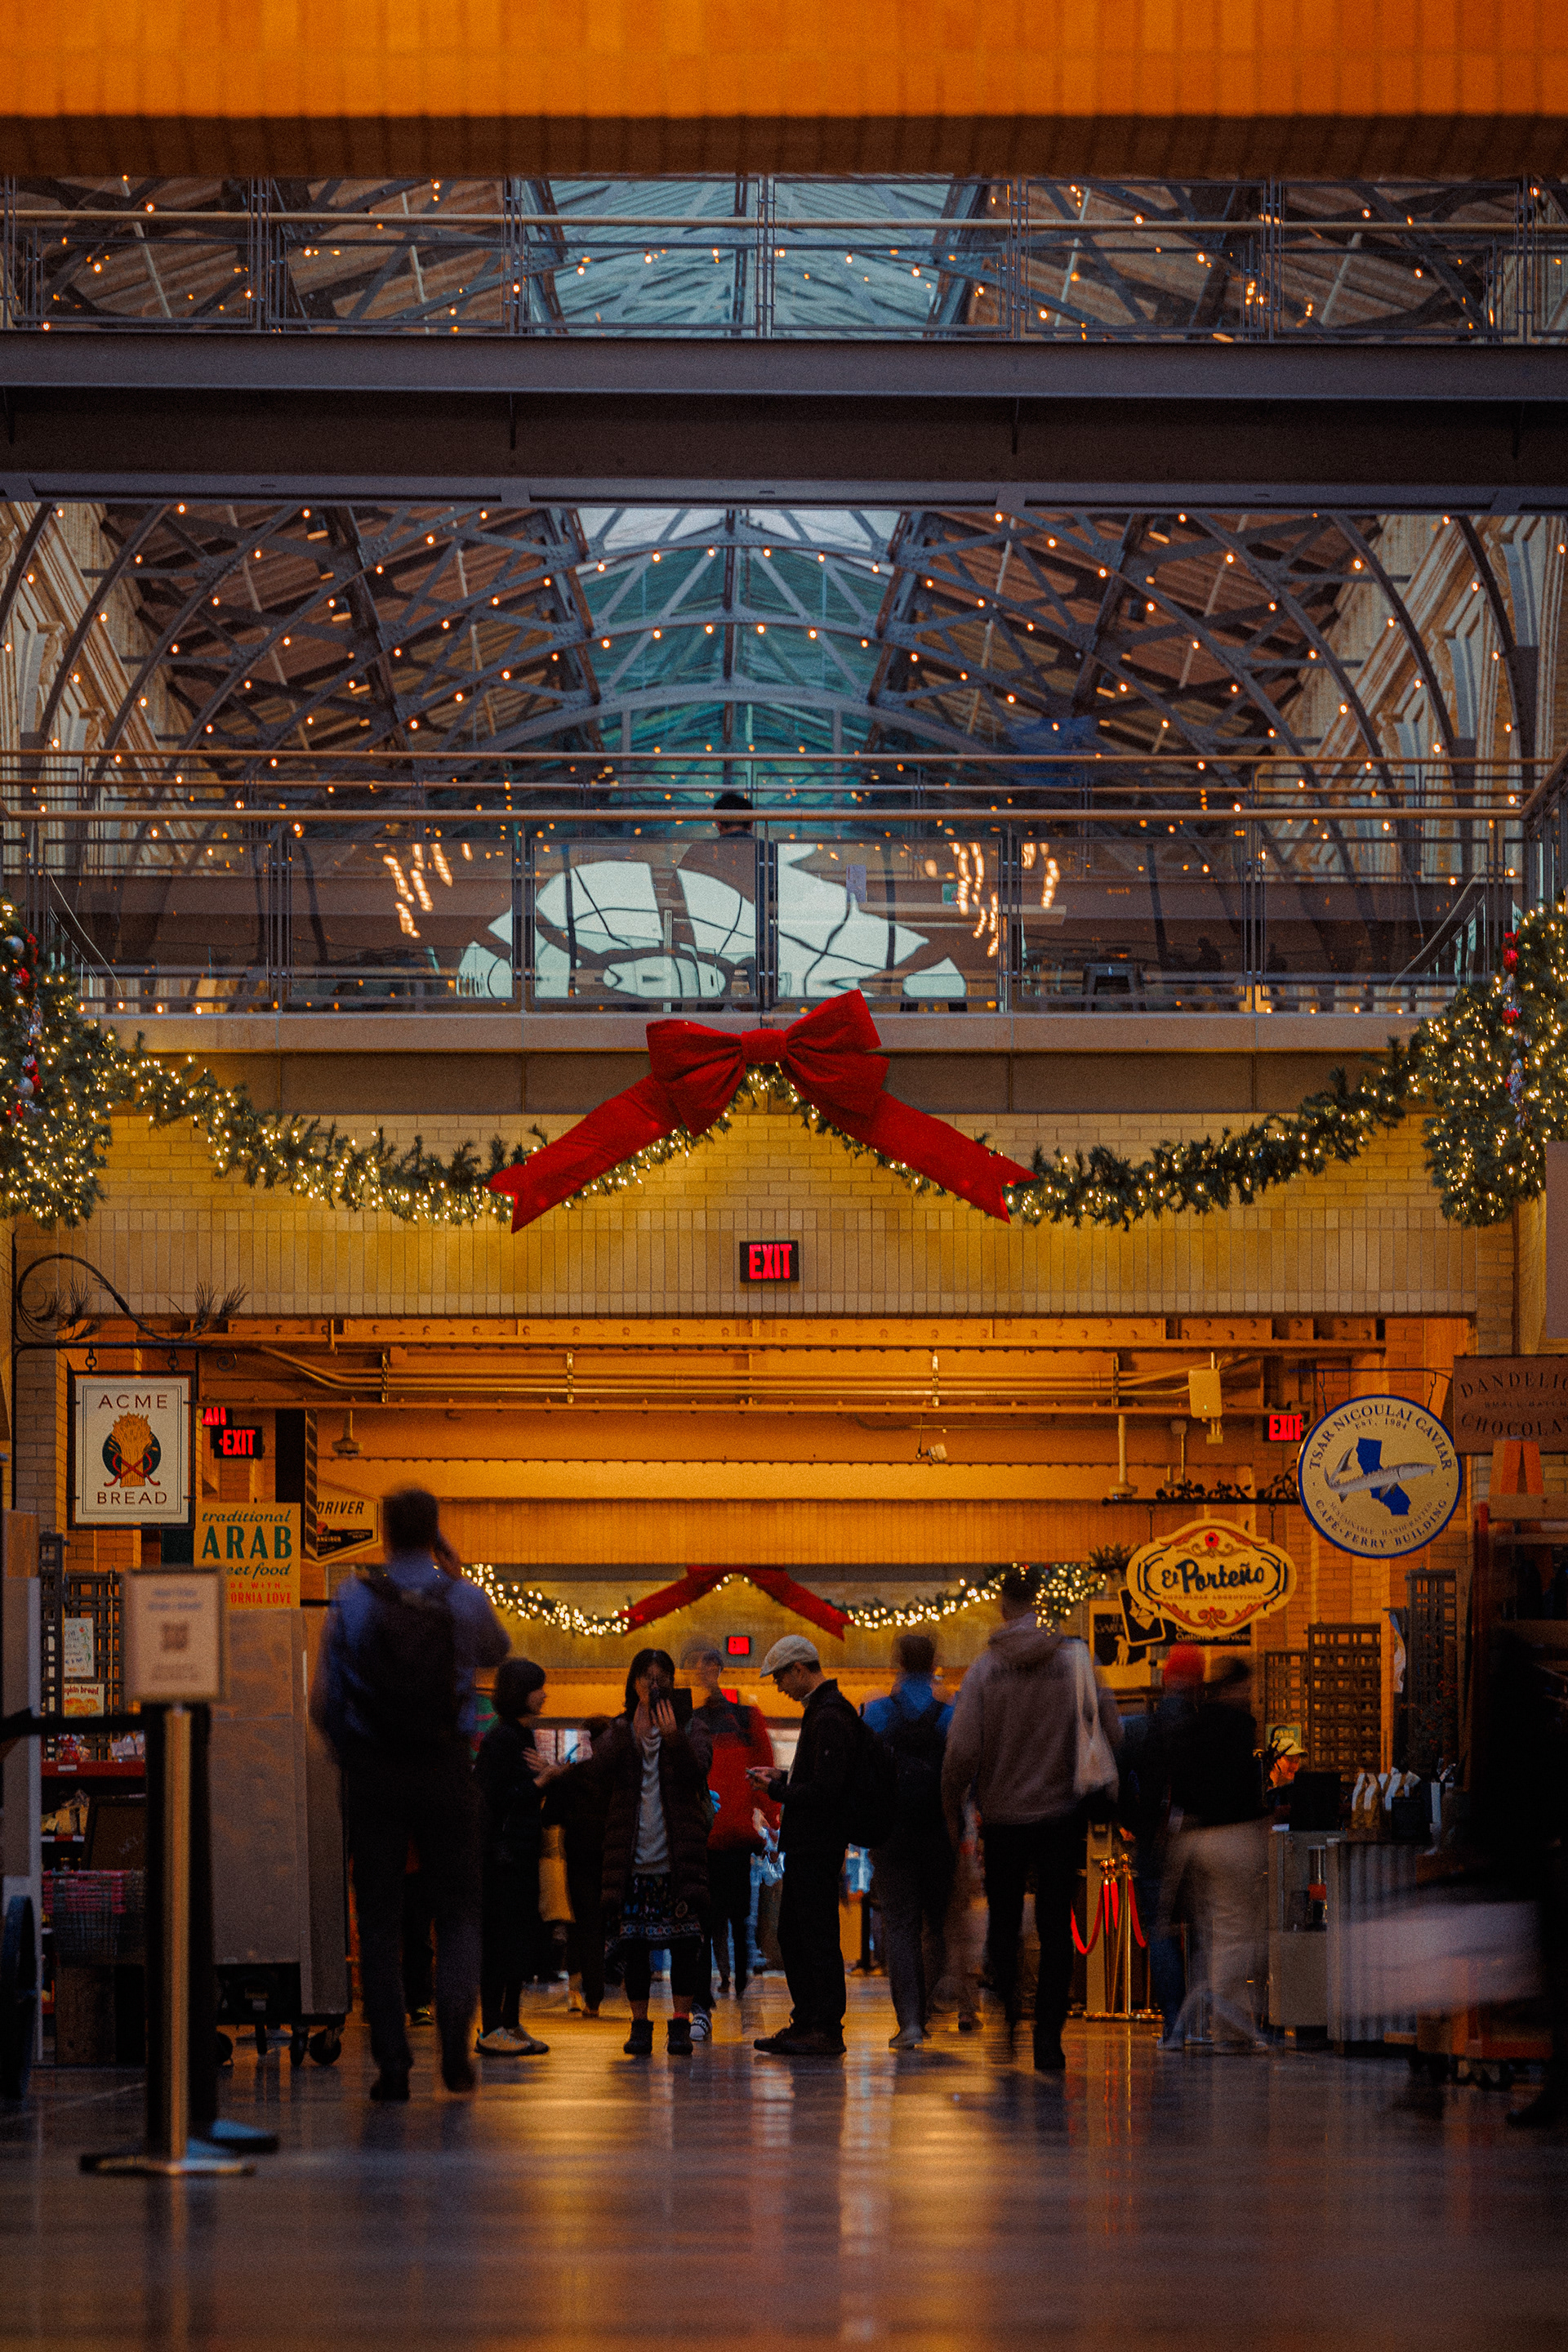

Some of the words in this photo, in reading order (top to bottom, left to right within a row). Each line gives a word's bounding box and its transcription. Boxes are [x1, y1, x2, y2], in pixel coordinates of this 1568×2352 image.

[749, 1244, 792, 1280] EXIT
[98, 1394, 167, 1410] ACME
[1269, 1414, 1302, 1441] EXIT
[222, 1429, 256, 1455] EXIT
[1308, 1430, 1334, 1470] TSAR
[1333, 1404, 1414, 1432] NICOULAI
[1415, 1417, 1452, 1471] CAVIAR
[97, 1491, 167, 1504] BREAD
[317, 1500, 364, 1514] DRIVER
[202, 1508, 292, 1522] traditional
[1343, 1530, 1387, 1548] FERRY
[1395, 1499, 1447, 1547] BUILDING
[201, 1525, 292, 1560] ARAB
[226, 1566, 250, 1576] eet
[252, 1561, 292, 1580] food
[1175, 1558, 1264, 1593] Porteño
[229, 1581, 243, 1589] DE
[251, 1581, 281, 1589] WITH
[230, 1591, 263, 1605] ORNIA
[266, 1591, 292, 1605] LOVE
[80, 1685, 99, 1695] bread
